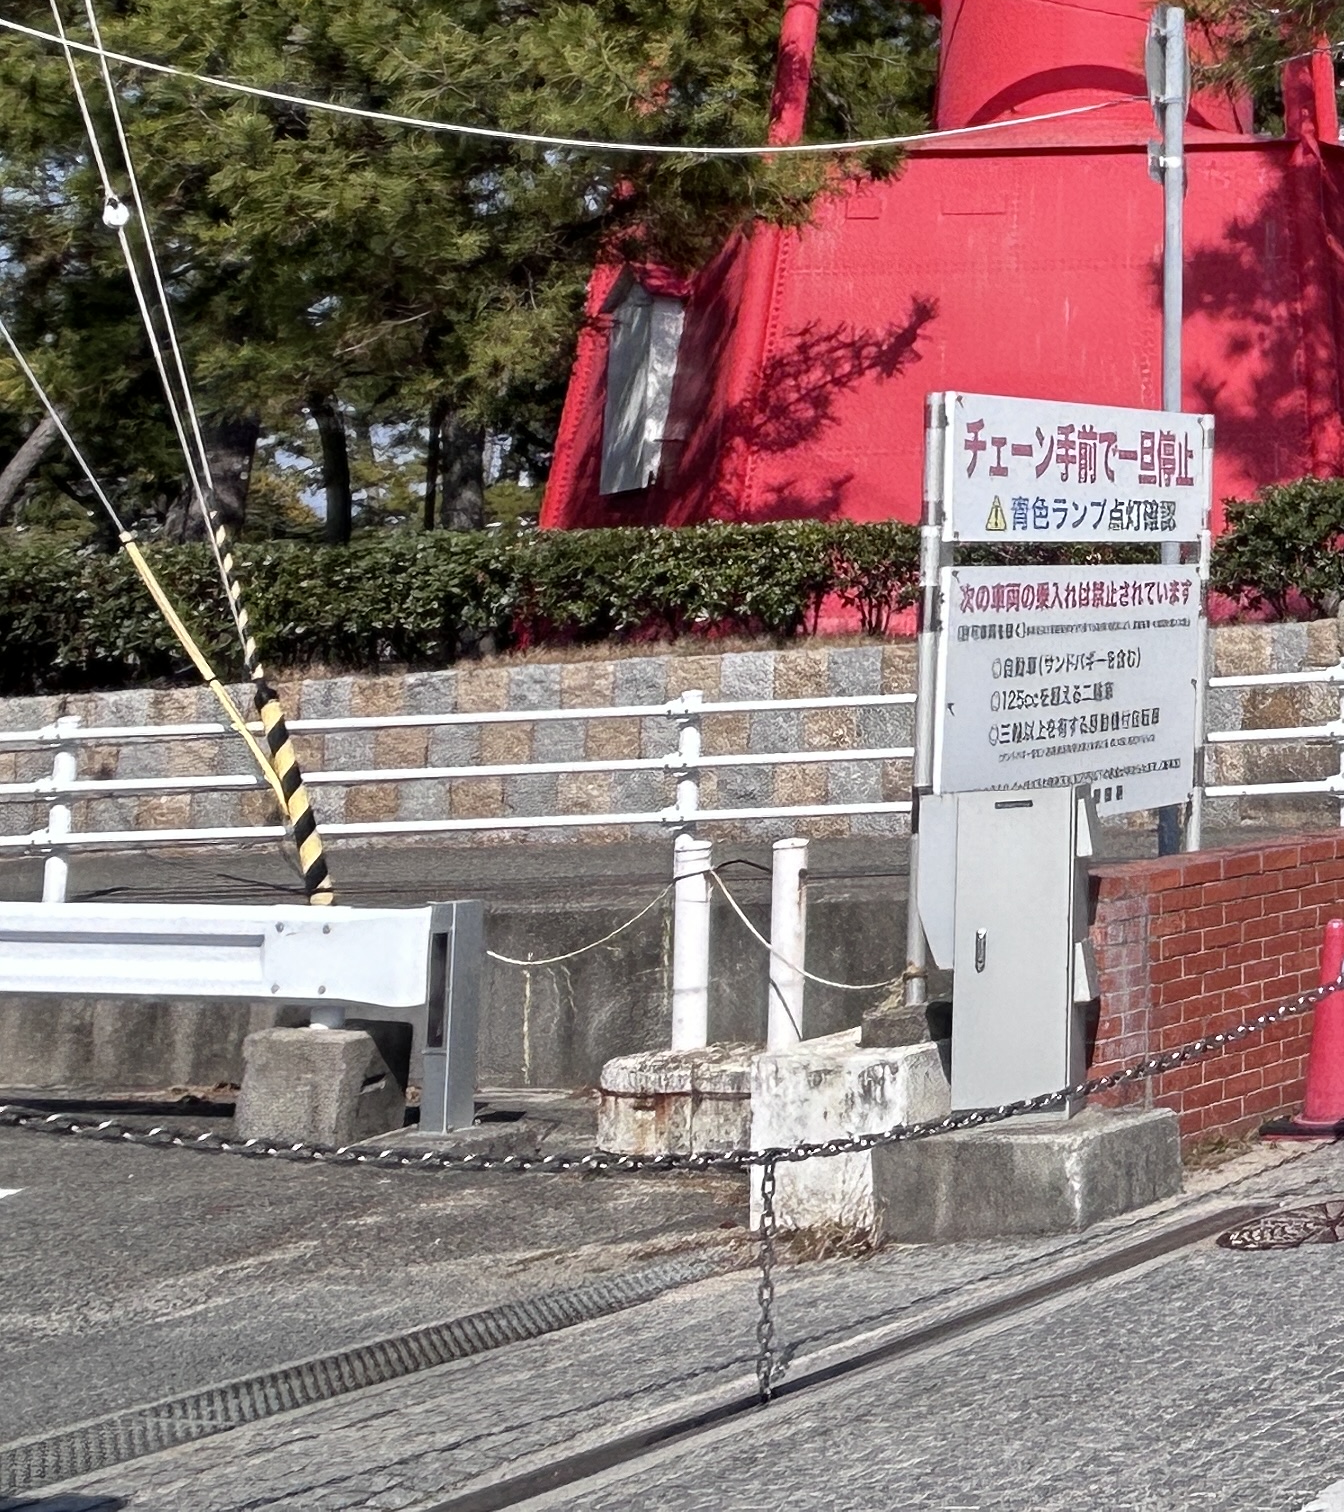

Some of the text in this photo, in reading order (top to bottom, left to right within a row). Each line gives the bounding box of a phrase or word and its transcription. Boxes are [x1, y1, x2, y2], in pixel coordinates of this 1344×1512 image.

[964, 418, 1194, 487] チェーン手前で一旦停止
